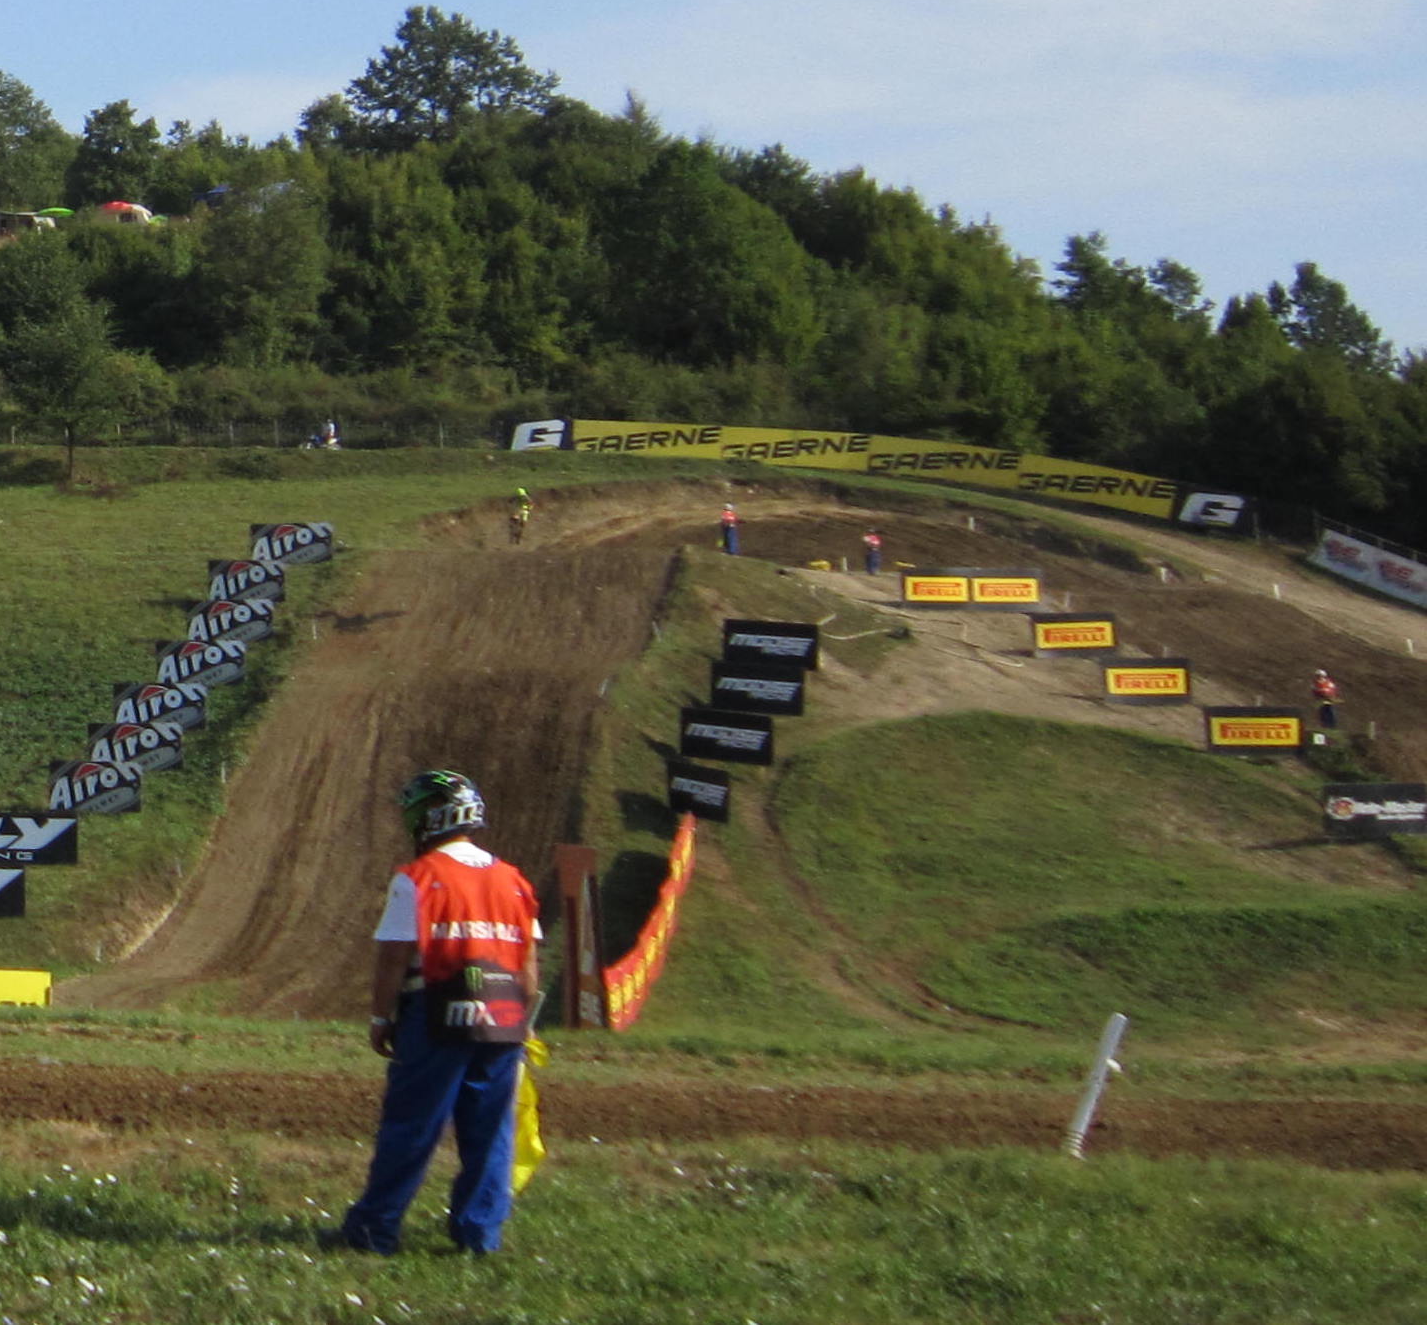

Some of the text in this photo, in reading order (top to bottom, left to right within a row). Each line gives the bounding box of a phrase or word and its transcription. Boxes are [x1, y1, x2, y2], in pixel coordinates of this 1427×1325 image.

[574, 427, 722, 453] GAERNE
[721, 434, 872, 460] GAERNE
[867, 452, 1022, 472] GAERNE
[1018, 472, 1178, 498] GAERNE
